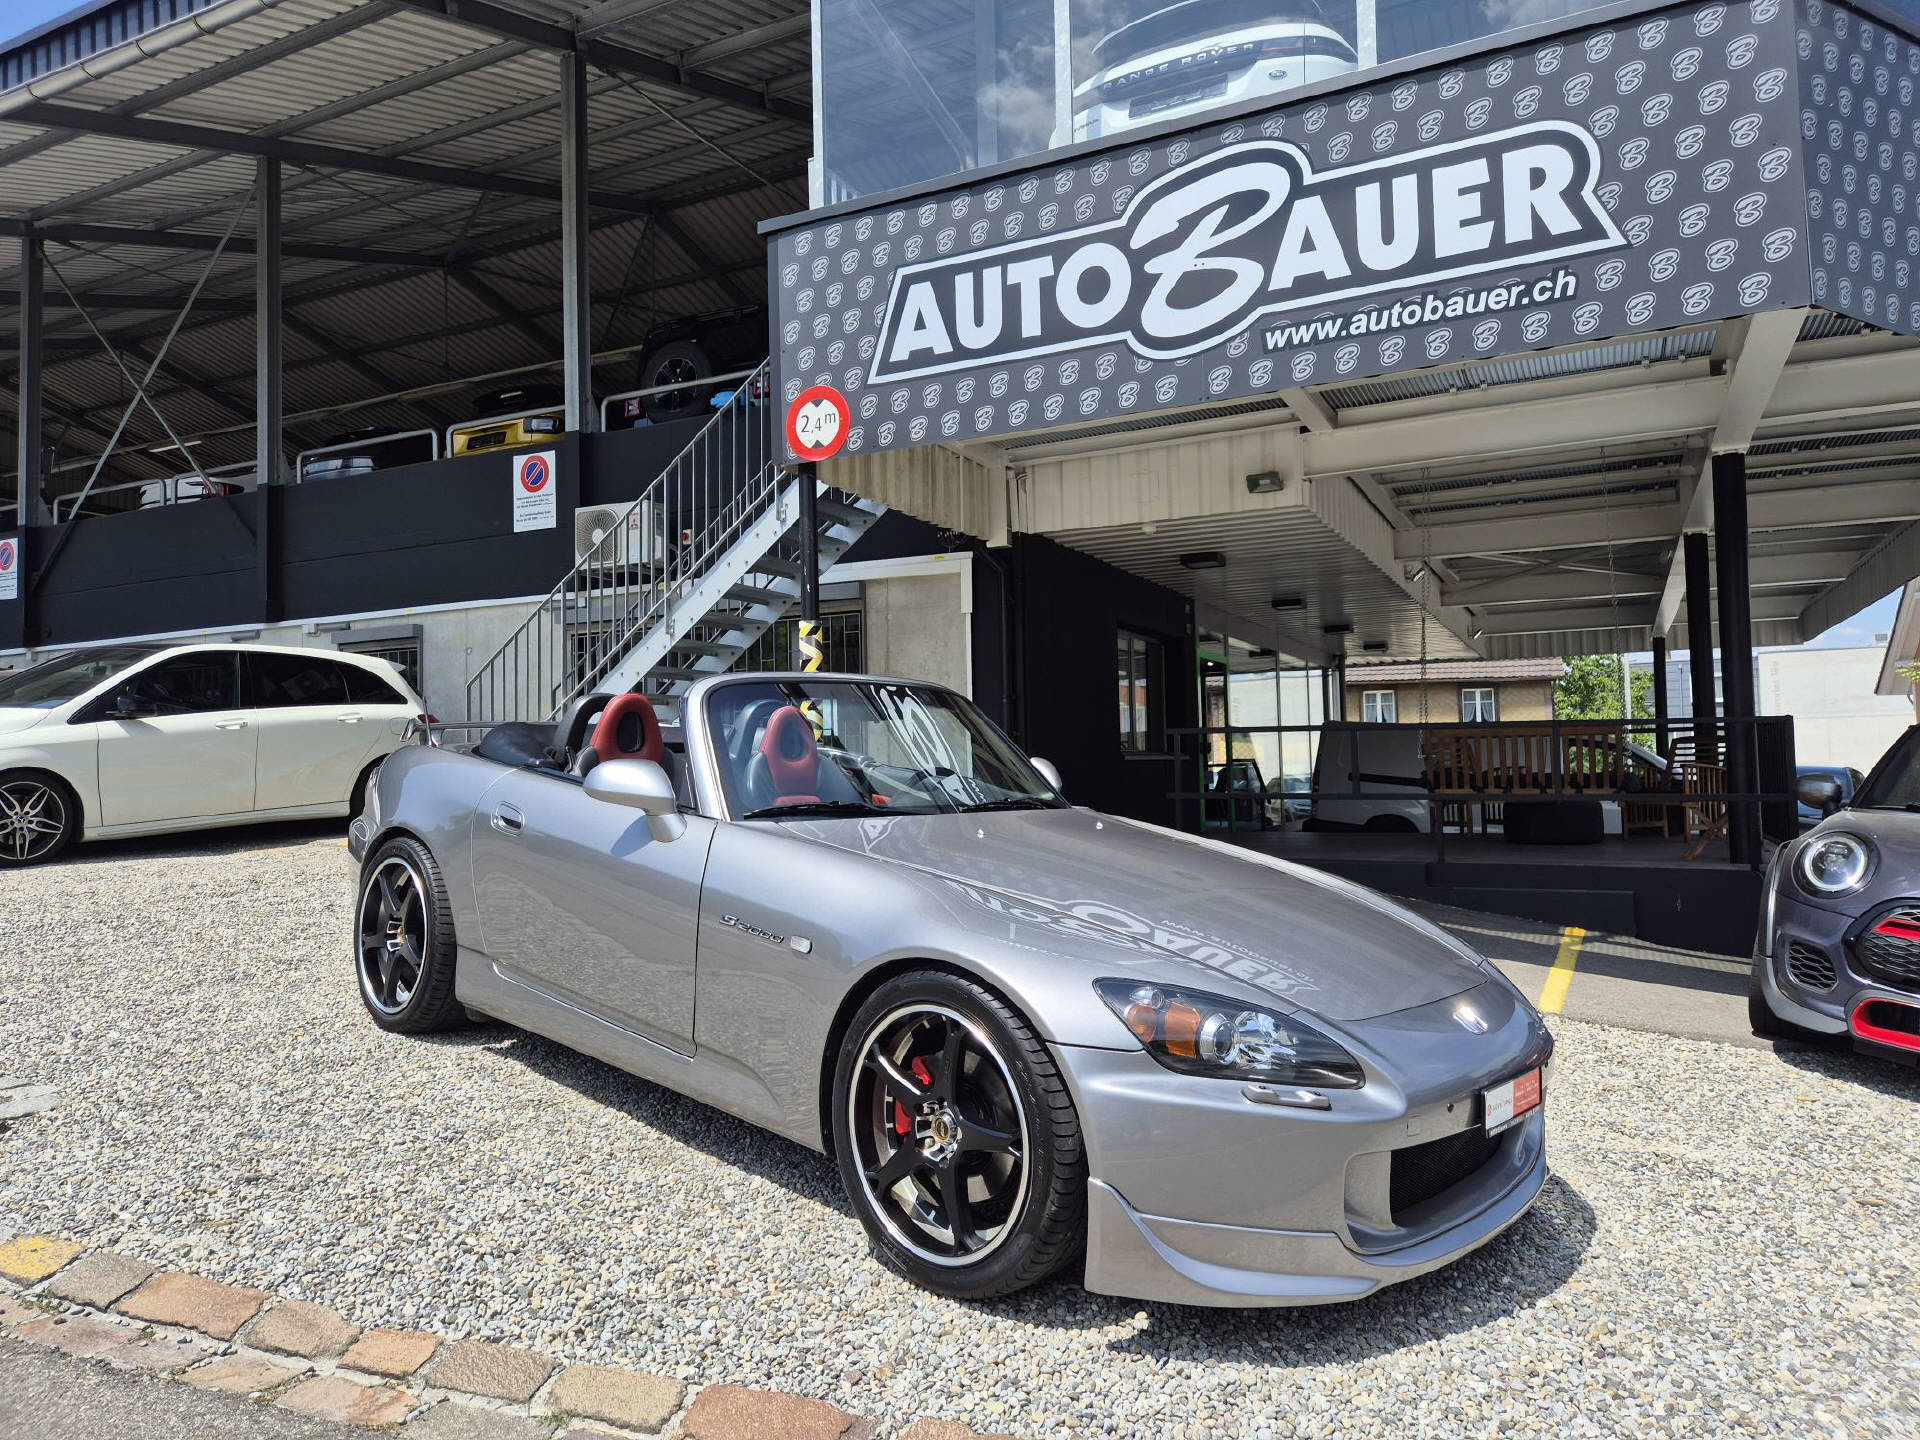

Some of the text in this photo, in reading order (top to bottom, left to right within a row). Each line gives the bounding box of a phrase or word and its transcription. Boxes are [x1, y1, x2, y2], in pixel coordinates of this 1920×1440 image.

[1103, 44, 1255, 90] RANGE ROVER
[889, 145, 1583, 363] AUTO BAUER
[1266, 270, 1577, 350] www.autobauer.ch
